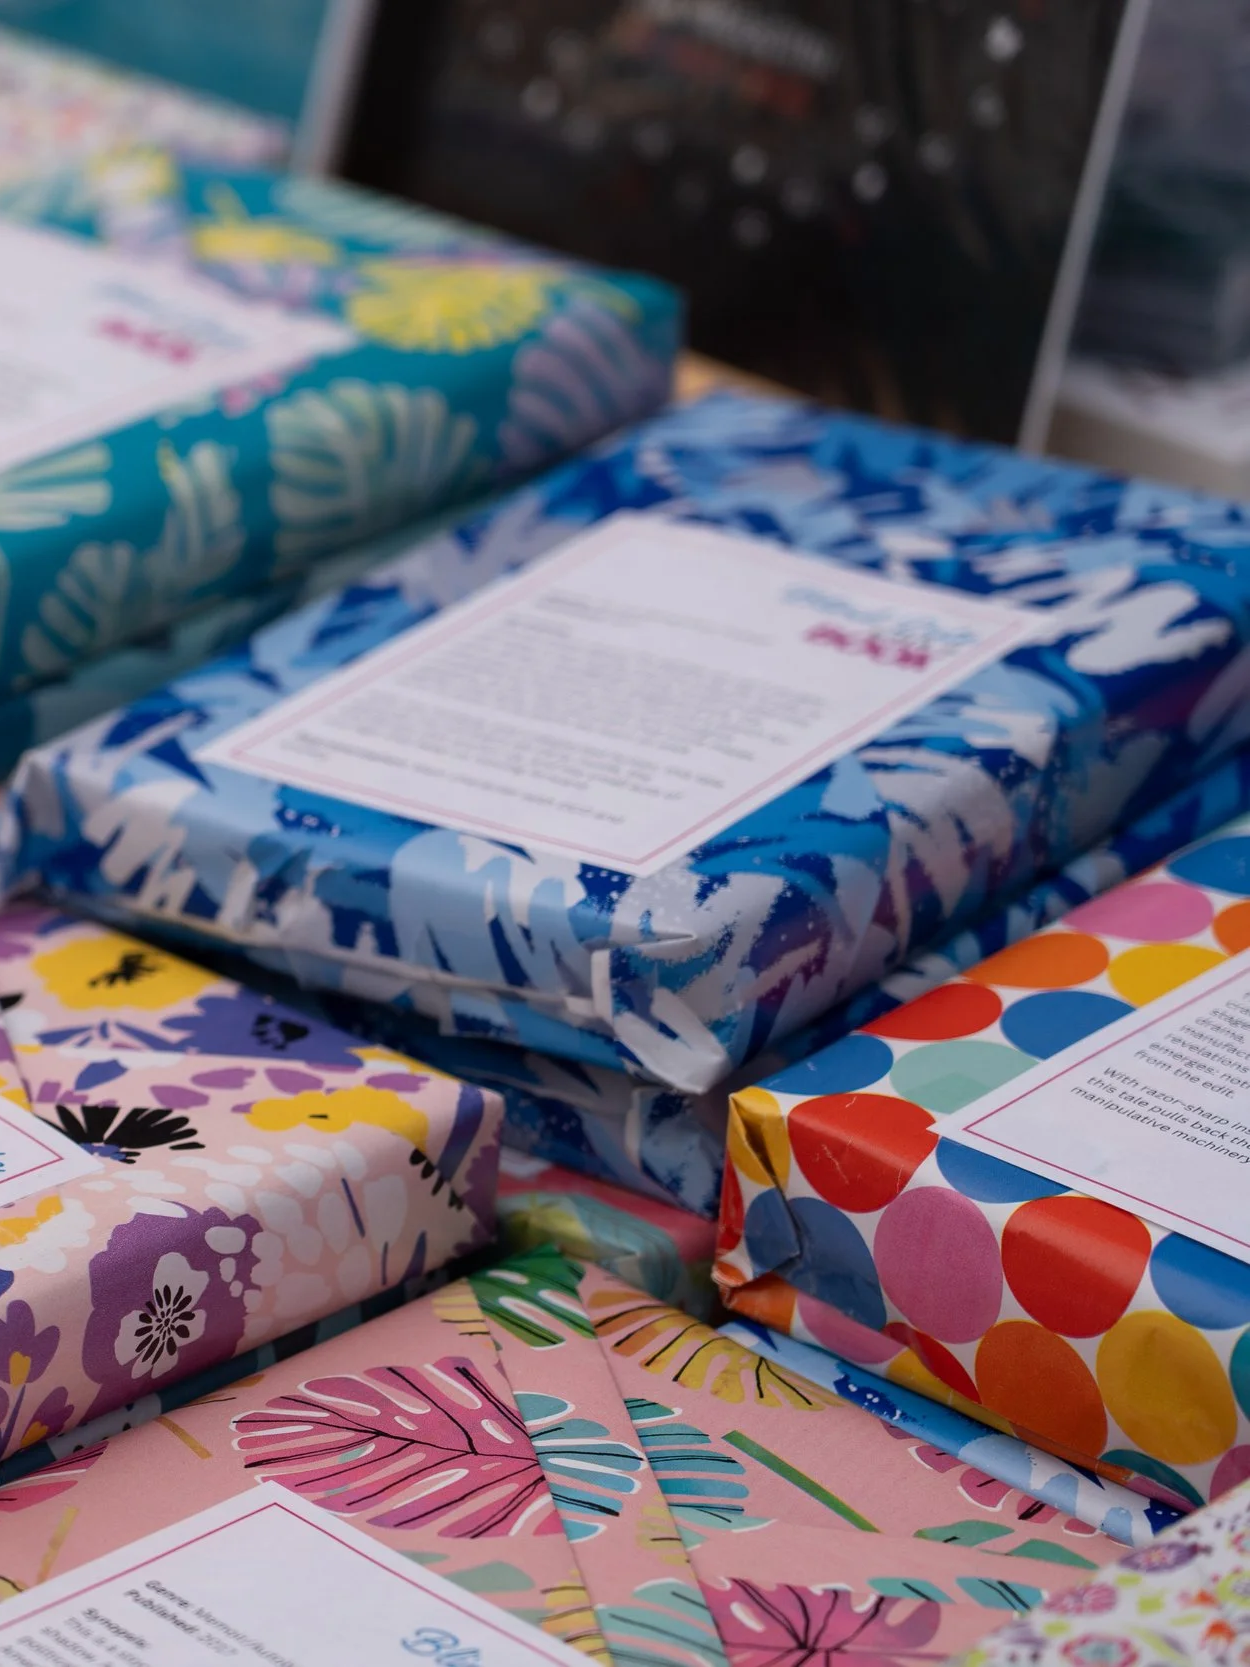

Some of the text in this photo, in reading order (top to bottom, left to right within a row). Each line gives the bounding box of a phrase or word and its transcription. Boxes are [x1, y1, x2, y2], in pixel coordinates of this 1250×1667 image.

[1133, 1049, 1236, 1099] from the edit.
[1149, 1043, 1250, 1090] emerges: not
[1164, 1033, 1250, 1074] revelations
[1086, 1076, 1118, 1094] this
[1118, 1091, 1150, 1108] tale
[1148, 1105, 1189, 1125] pulls
[1190, 1121, 1230, 1140] back
[1103, 1067, 1139, 1088] With
[1140, 1085, 1230, 1126] razor-sharp
[1070, 1086, 1250, 1164] manipulative machinery
